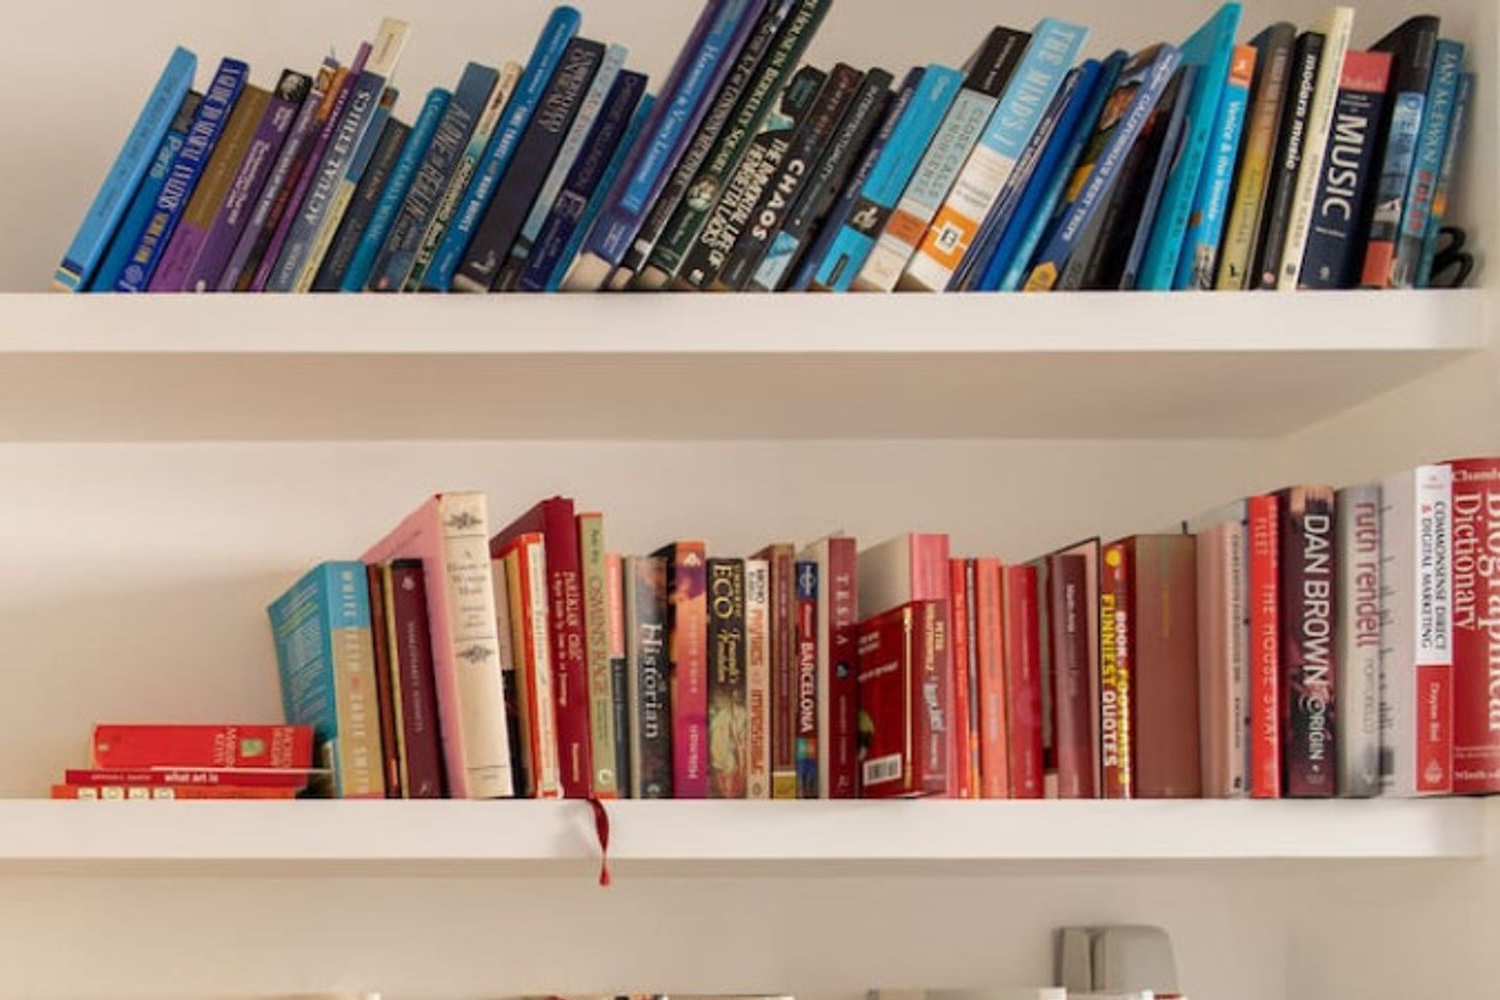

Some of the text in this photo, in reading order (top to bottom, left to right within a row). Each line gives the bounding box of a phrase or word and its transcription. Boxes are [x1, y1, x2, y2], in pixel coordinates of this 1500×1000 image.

[304, 89, 373, 226] ACTUAL ETHICS
[1285, 54, 1317, 171] modern music
[751, 158, 805, 241] CHAOS
[1322, 114, 1368, 221] MUSIC
[1304, 514, 1330, 573] DAN
[1355, 502, 1380, 552] ruth
[1454, 492, 1483, 631] Dictionary
[712, 564, 734, 620] ECO
[836, 573, 849, 647] TESLA
[1303, 580, 1330, 686] BROWN
[1356, 562, 1379, 648] rendell
[640, 622, 663, 738] Historian
[801, 642, 814, 732] BARCELONA
[1101, 594, 1116, 766] FUNNIEST QUOTES
